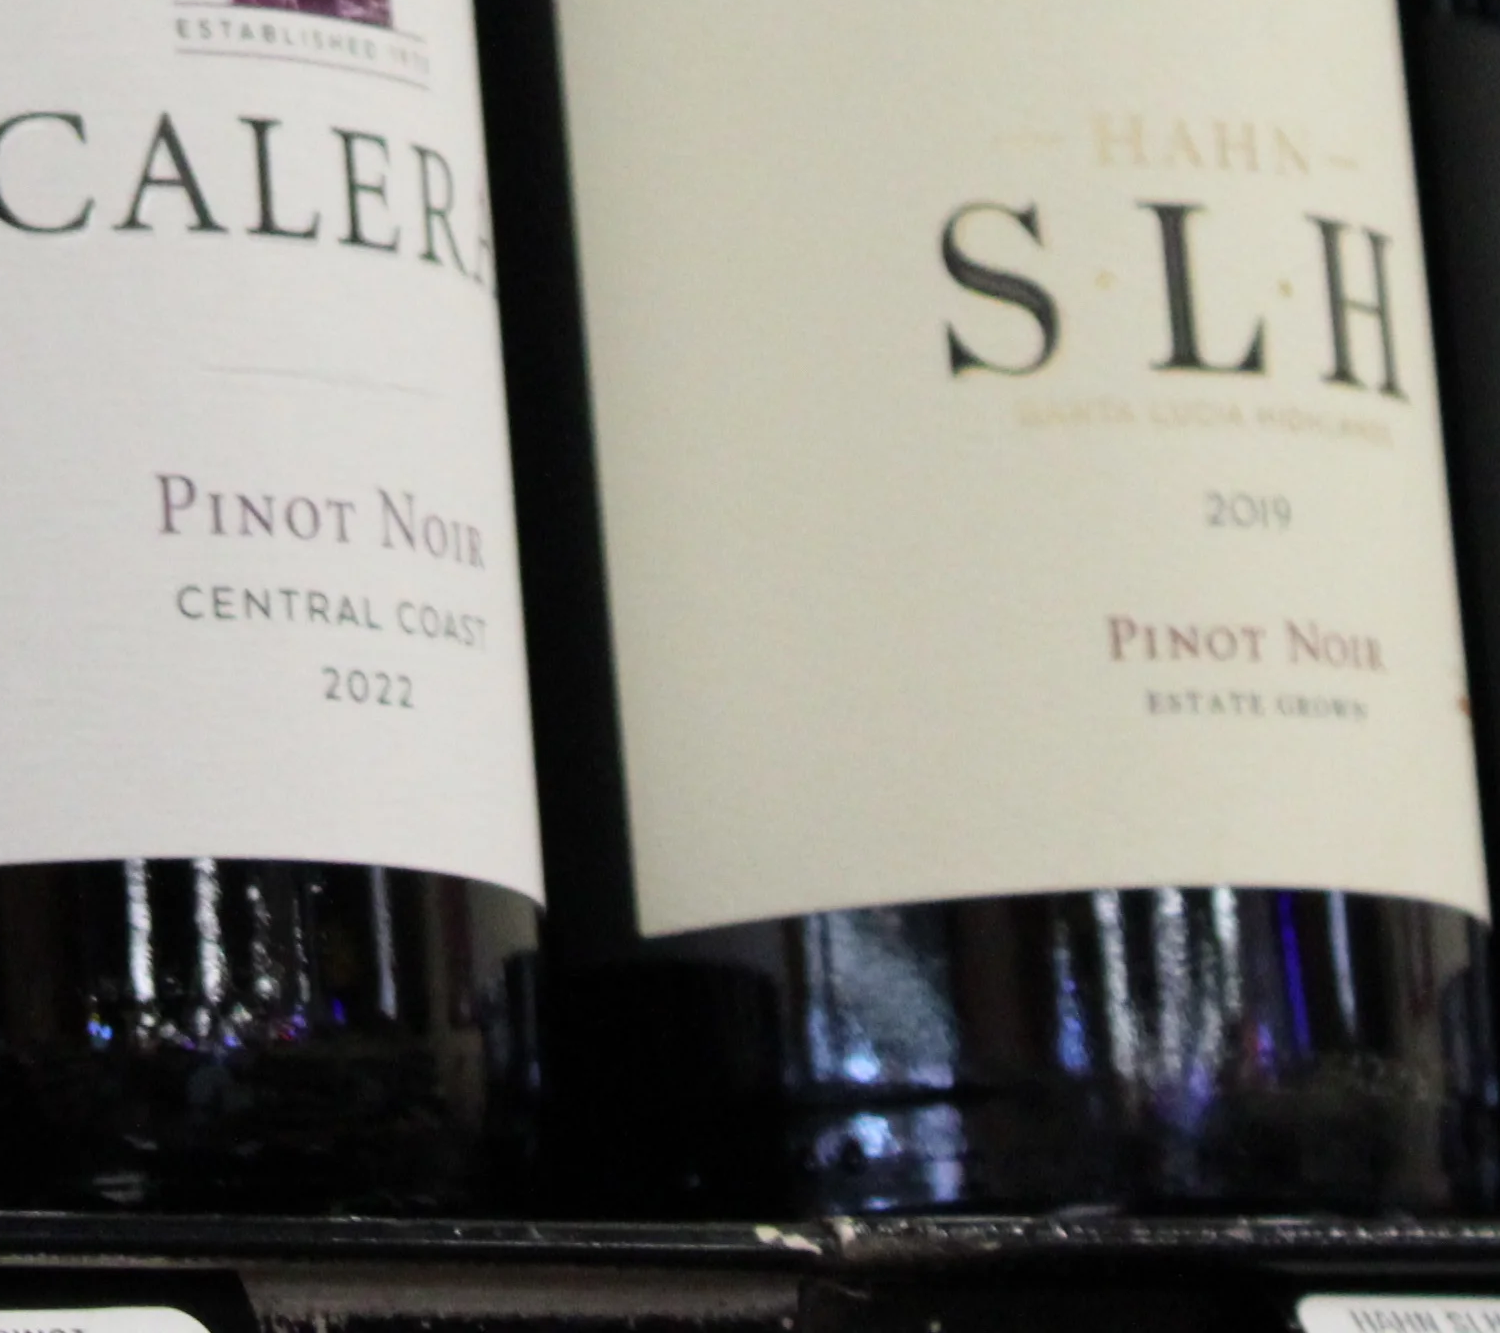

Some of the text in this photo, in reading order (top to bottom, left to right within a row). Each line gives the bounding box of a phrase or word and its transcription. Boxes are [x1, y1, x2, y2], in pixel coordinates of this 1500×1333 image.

[1088, 111, 1311, 176] HAHN
[155, 473, 486, 571] PINOT NOIR
[1203, 490, 1294, 530] 2019
[175, 584, 487, 649] CENTRAL COAST
[1106, 614, 1268, 664] PINOT
[321, 666, 416, 710] 2022
